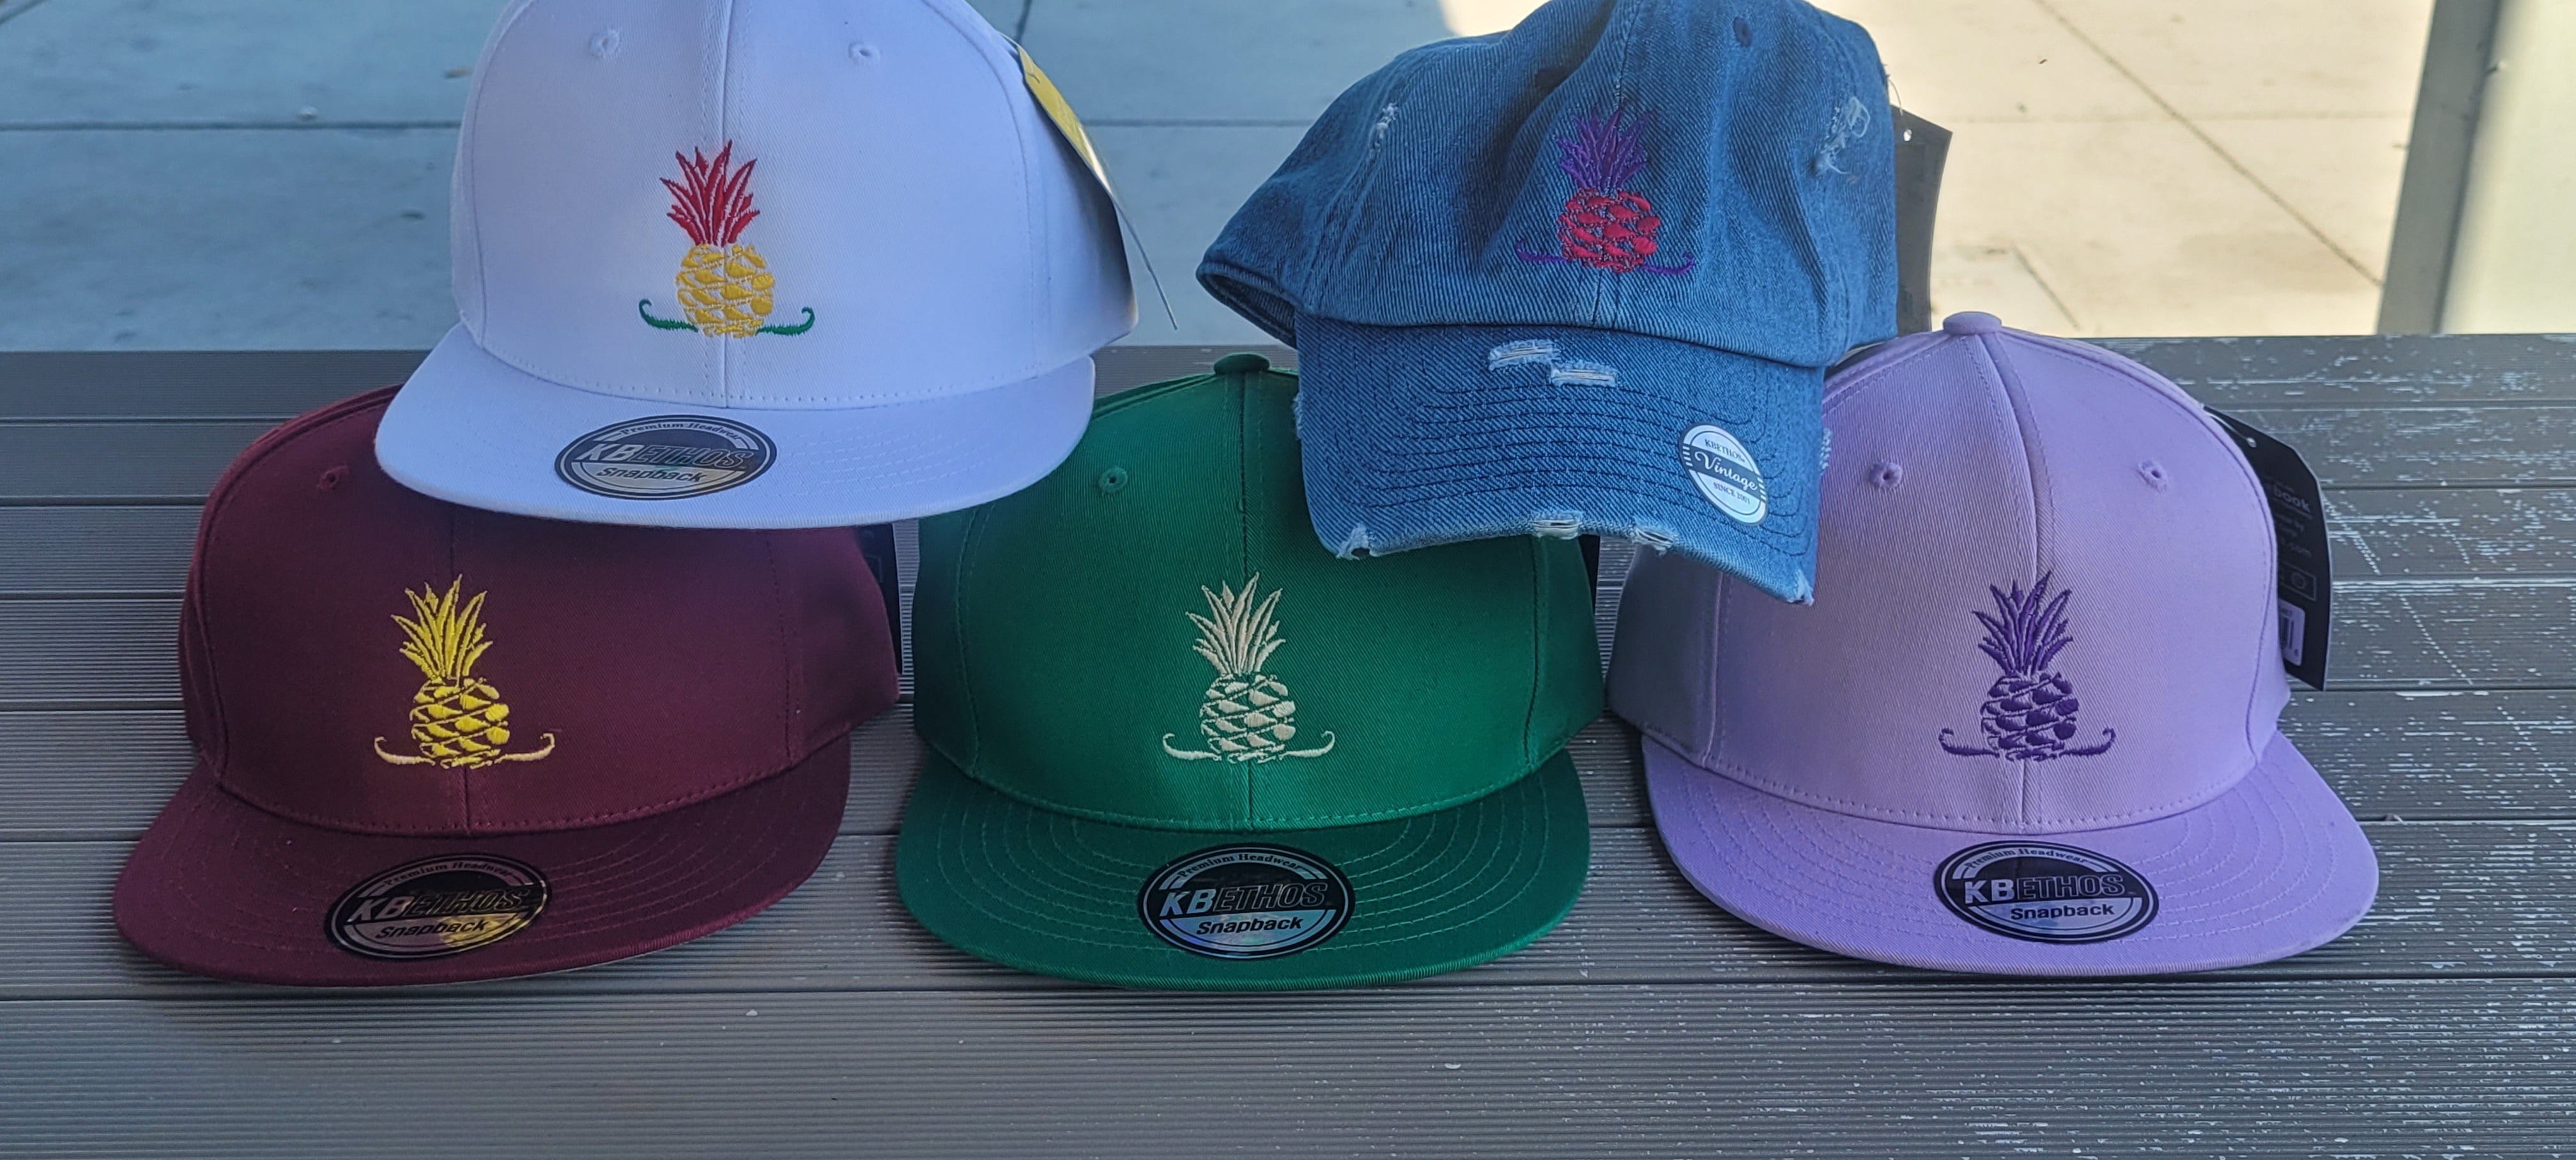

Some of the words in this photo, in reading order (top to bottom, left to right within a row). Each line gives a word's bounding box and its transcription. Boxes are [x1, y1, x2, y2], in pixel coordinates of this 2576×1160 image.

[620, 422, 684, 436] Premium
[689, 422, 741, 441] Headwear
[575, 443, 755, 469] KBETHOS
[595, 467, 705, 482] Snapback
[1695, 451, 1758, 491] Vintage
[2273, 482, 2311, 514] book
[1179, 856, 1236, 878] Premium
[1239, 853, 1299, 870] Headwear
[1965, 849, 2016, 870] Premium
[2019, 848, 2087, 865] Headwear
[383, 862, 447, 887] Premium
[451, 860, 514, 878] Headwear
[1159, 882, 1328, 917] KBETHOS
[1965, 874, 2126, 904] KBETHOS
[346, 887, 530, 923] KBETHOS
[2011, 903, 2115, 920] Snapback
[376, 919, 491, 939] Snapback
[1195, 916, 1303, 936] Snapback
